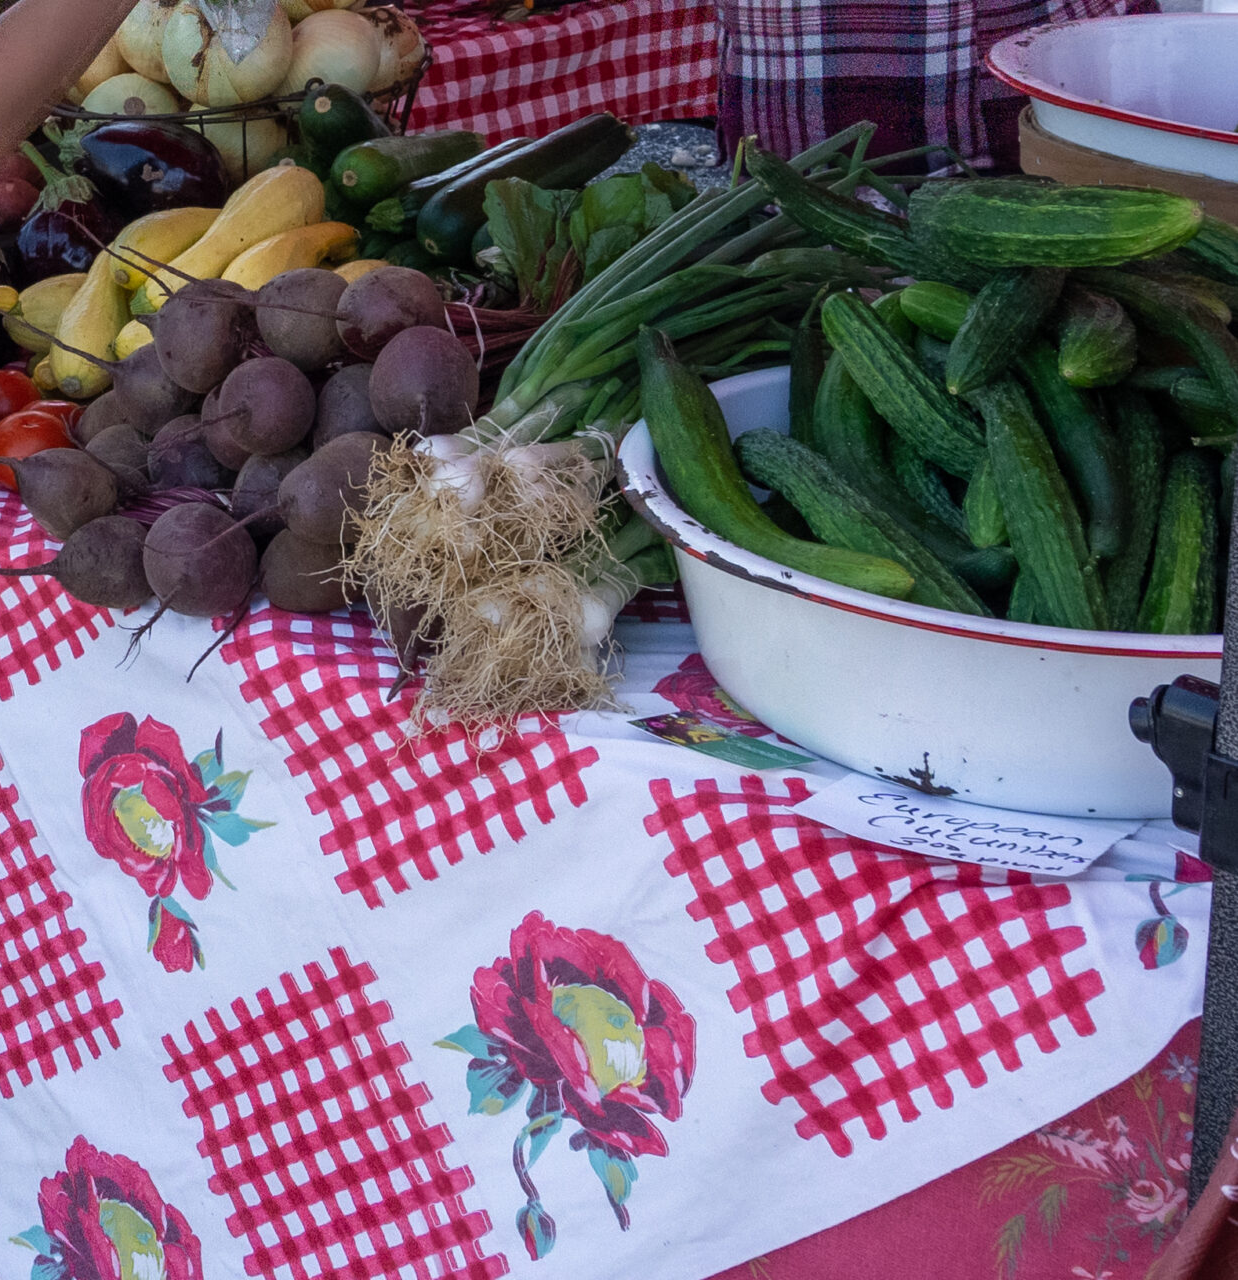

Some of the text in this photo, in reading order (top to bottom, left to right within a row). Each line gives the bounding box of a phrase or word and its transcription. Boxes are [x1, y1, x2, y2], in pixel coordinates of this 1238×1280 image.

[858, 793, 1083, 846] European
[868, 815, 1092, 863] Cucumbers
[976, 856, 1064, 871] pound
